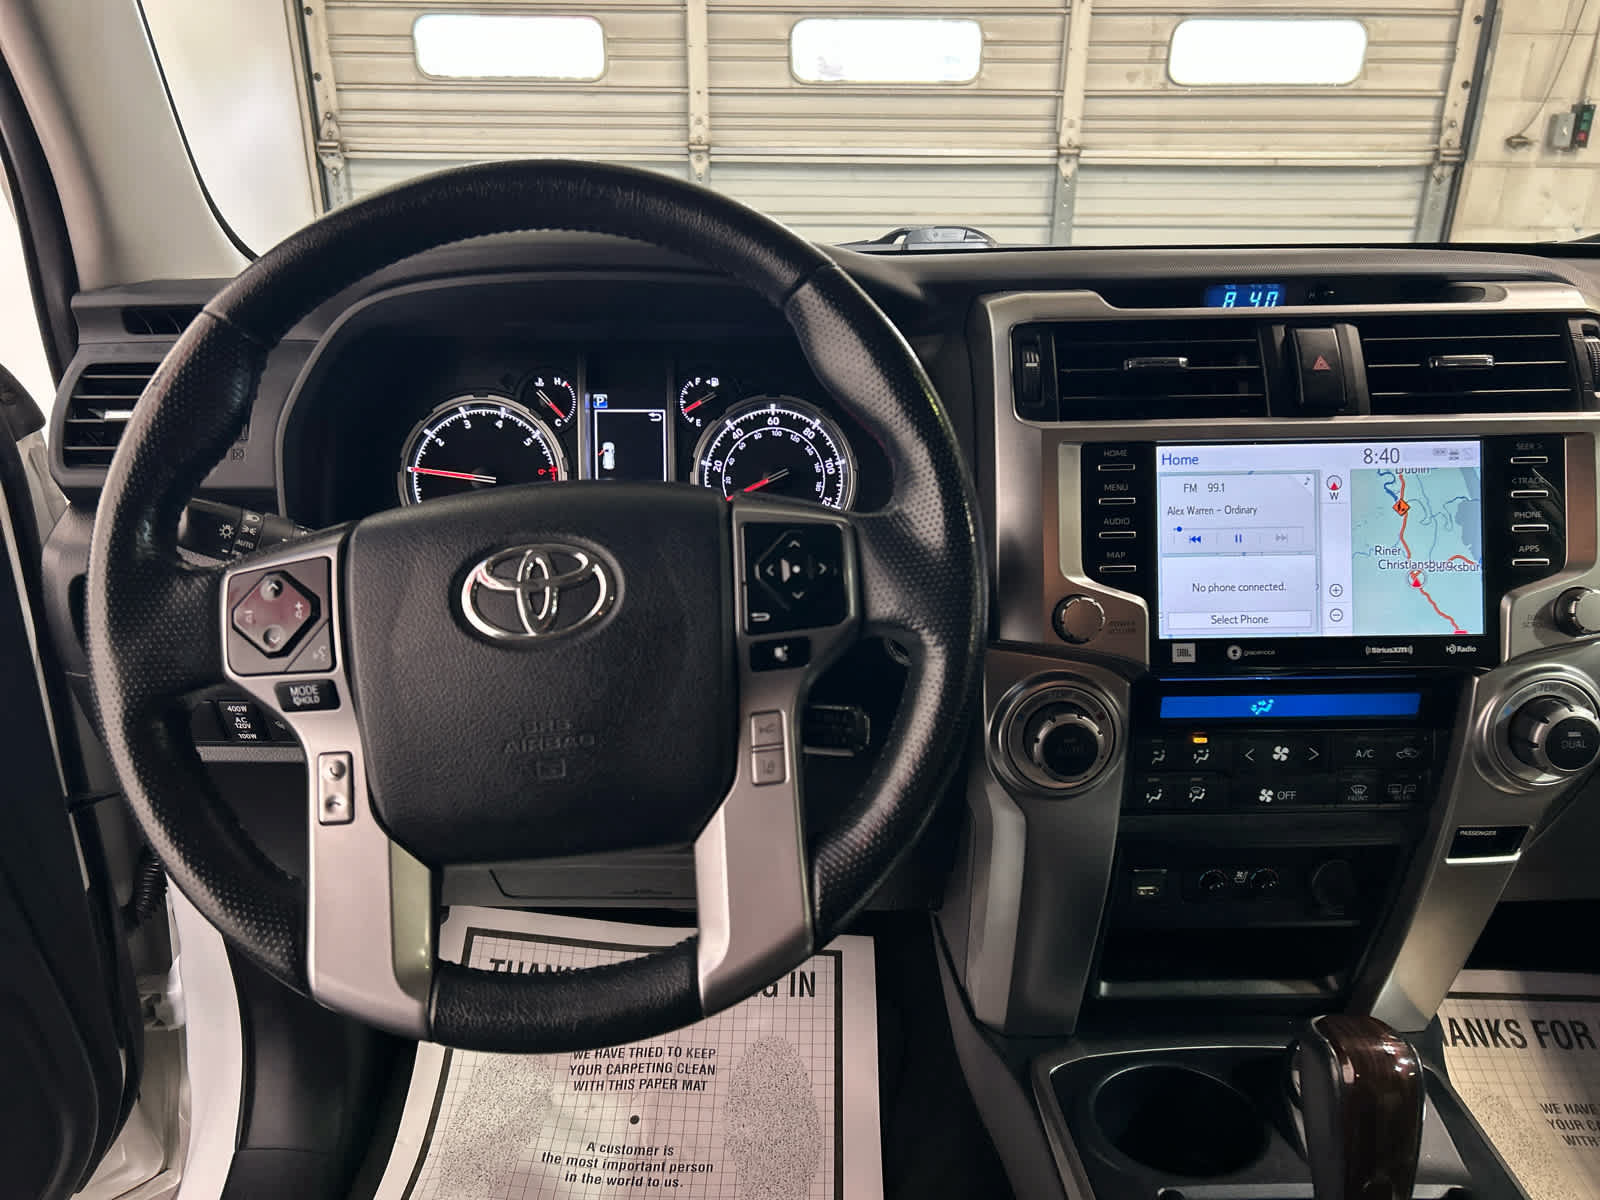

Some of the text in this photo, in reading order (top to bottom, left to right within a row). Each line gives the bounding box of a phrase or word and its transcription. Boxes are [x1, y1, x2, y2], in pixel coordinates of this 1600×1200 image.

[553, 377, 562, 386] H
[596, 396, 605, 407] P
[464, 420, 472, 430] 3
[495, 420, 504, 429] 4
[554, 418, 562, 427] C
[696, 419, 702, 427] E
[767, 416, 780, 426] 60
[731, 428, 744, 441] 40
[802, 427, 816, 440] 80
[435, 437, 445, 447] 2
[523, 437, 533, 447] 5
[1103, 449, 1128, 457] HOME
[1363, 447, 1400, 465] 8:40
[1161, 453, 1199, 466] Home
[713, 460, 723, 472] 20
[823, 457, 836, 475] 100
[1104, 483, 1129, 491] MENU
[1183, 483, 1225, 493] FM 99.1
[821, 496, 833, 507] 12
[1329, 492, 1339, 501] W
[1167, 506, 1184, 516] Alex
[1187, 506, 1214, 516] Warren
[1224, 505, 1258, 517] Ordinary
[1514, 511, 1542, 519] PHONE
[1103, 517, 1130, 525] AUDIO
[235, 538, 254, 549] AUTO
[1518, 545, 1540, 553] APPS
[1107, 551, 1126, 559] MAP
[1375, 545, 1401, 556] Riner
[1378, 559, 1454, 572] Christiansburg
[1192, 582, 1287, 595] No phone connected.
[1211, 614, 1269, 625] Select Phone
[1457, 645, 1477, 653] Radio
[289, 685, 319, 696] MODE
[302, 696, 320, 704] HOLD
[1561, 740, 1587, 750] DUAL
[1355, 749, 1375, 759] A/C
[1276, 791, 1297, 800] OFF
[790, 971, 816, 998] IN
[1530, 1019, 1597, 1050] FOR
[573, 1046, 716, 1060] WE HAVE TRIED TO KEEP
[569, 1062, 716, 1076] YOUR CARPETING CLEAN
[573, 1078, 708, 1092] WITH THIS PAPER MAT
[1540, 1103, 1598, 1115] WE HAVE
[1546, 1118, 1585, 1131] YOUR
[1562, 1135, 1599, 1147] WITH
[586, 1142, 674, 1156] A customer is
[542, 1151, 713, 1176] the most important person
[565, 1171, 684, 1188] in the world to us.
